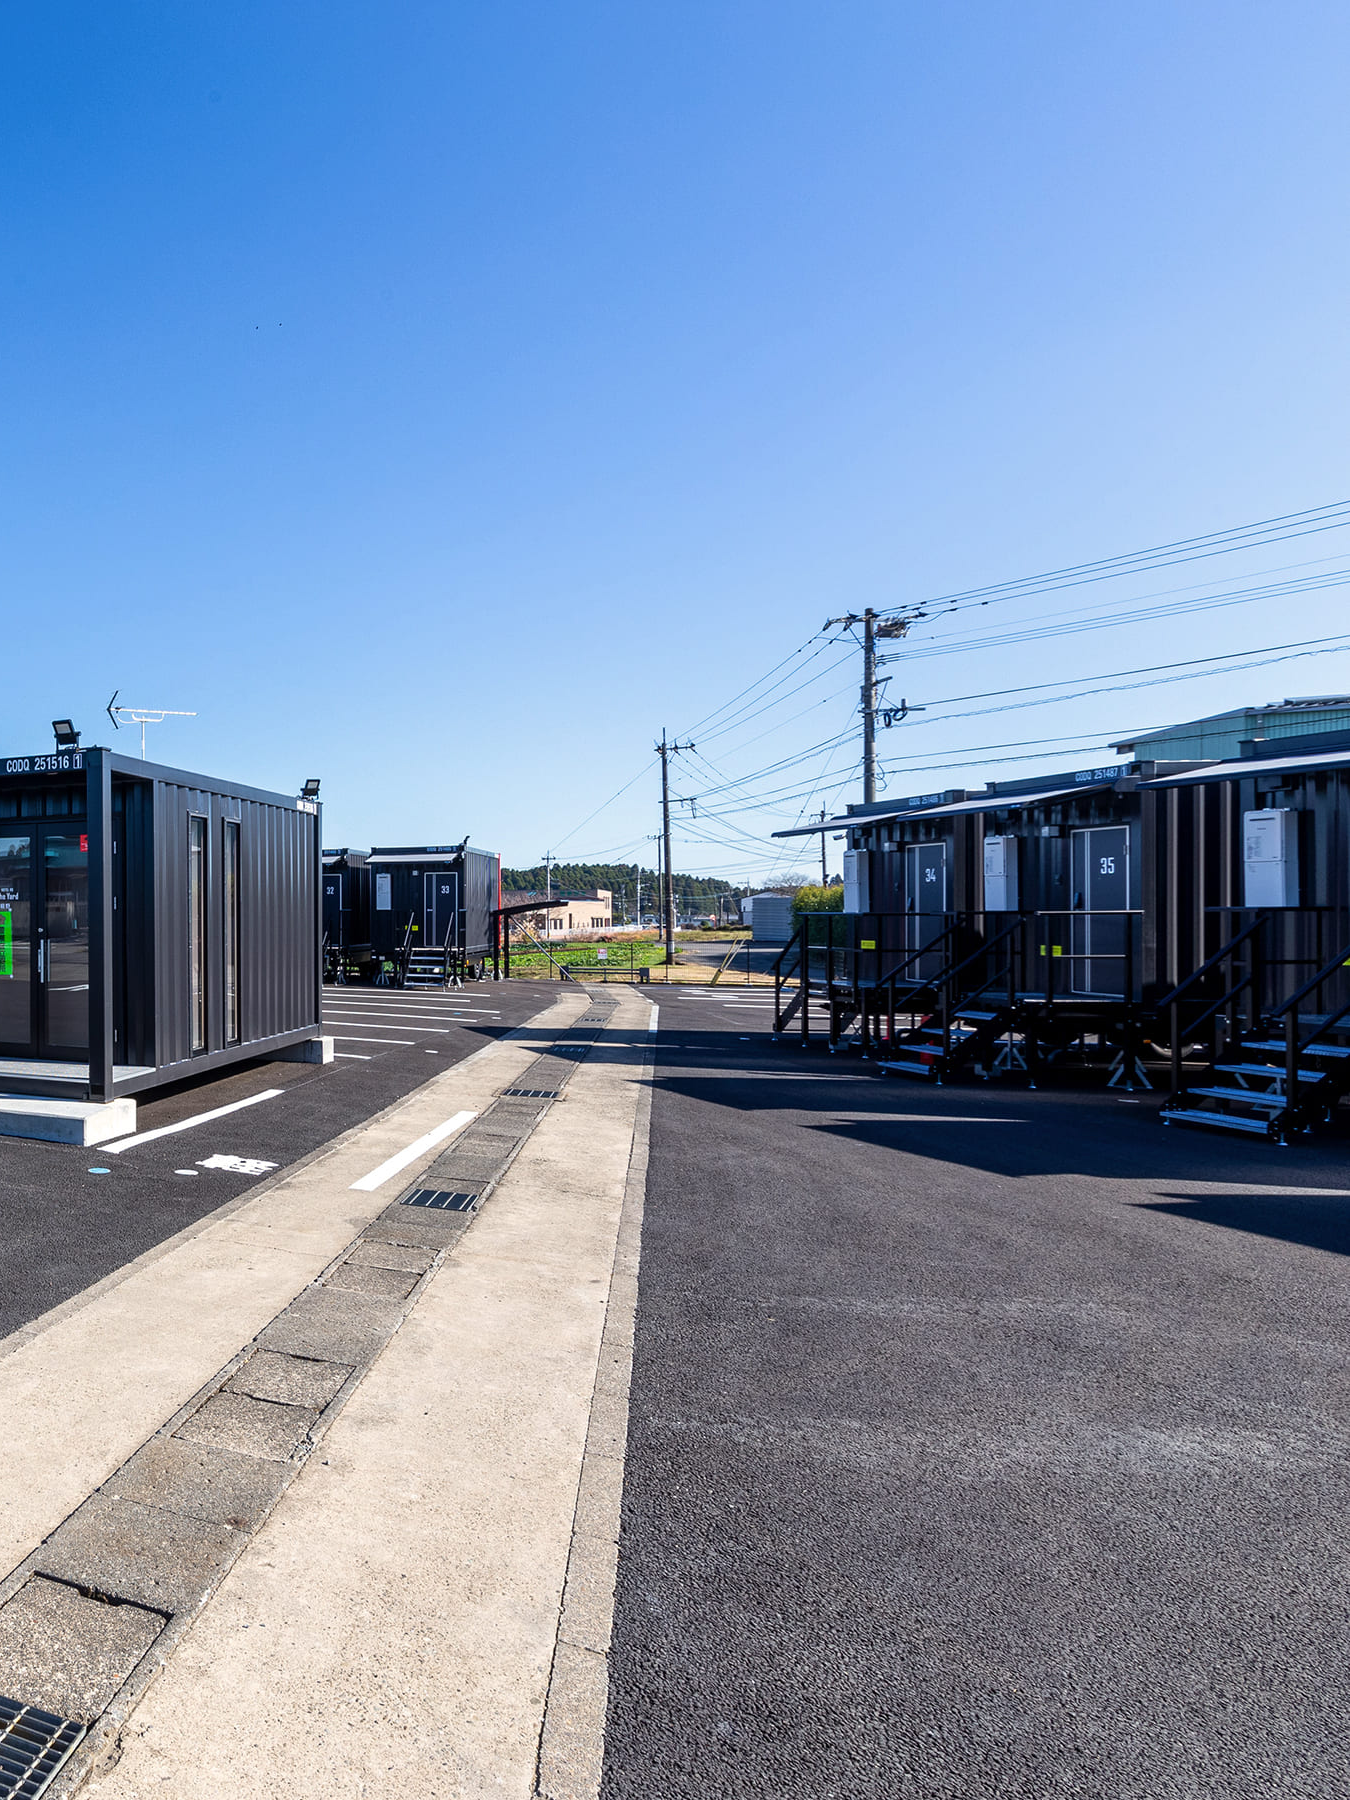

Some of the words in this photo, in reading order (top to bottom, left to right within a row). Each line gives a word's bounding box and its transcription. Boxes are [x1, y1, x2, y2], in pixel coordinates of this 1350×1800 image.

[7, 759, 29, 772] CODQ
[34, 756, 69, 770] 251516
[1101, 857, 1115, 874] 35
[925, 868, 936, 882] 34
[326, 887, 334, 895] 32
[441, 885, 450, 894] 33
